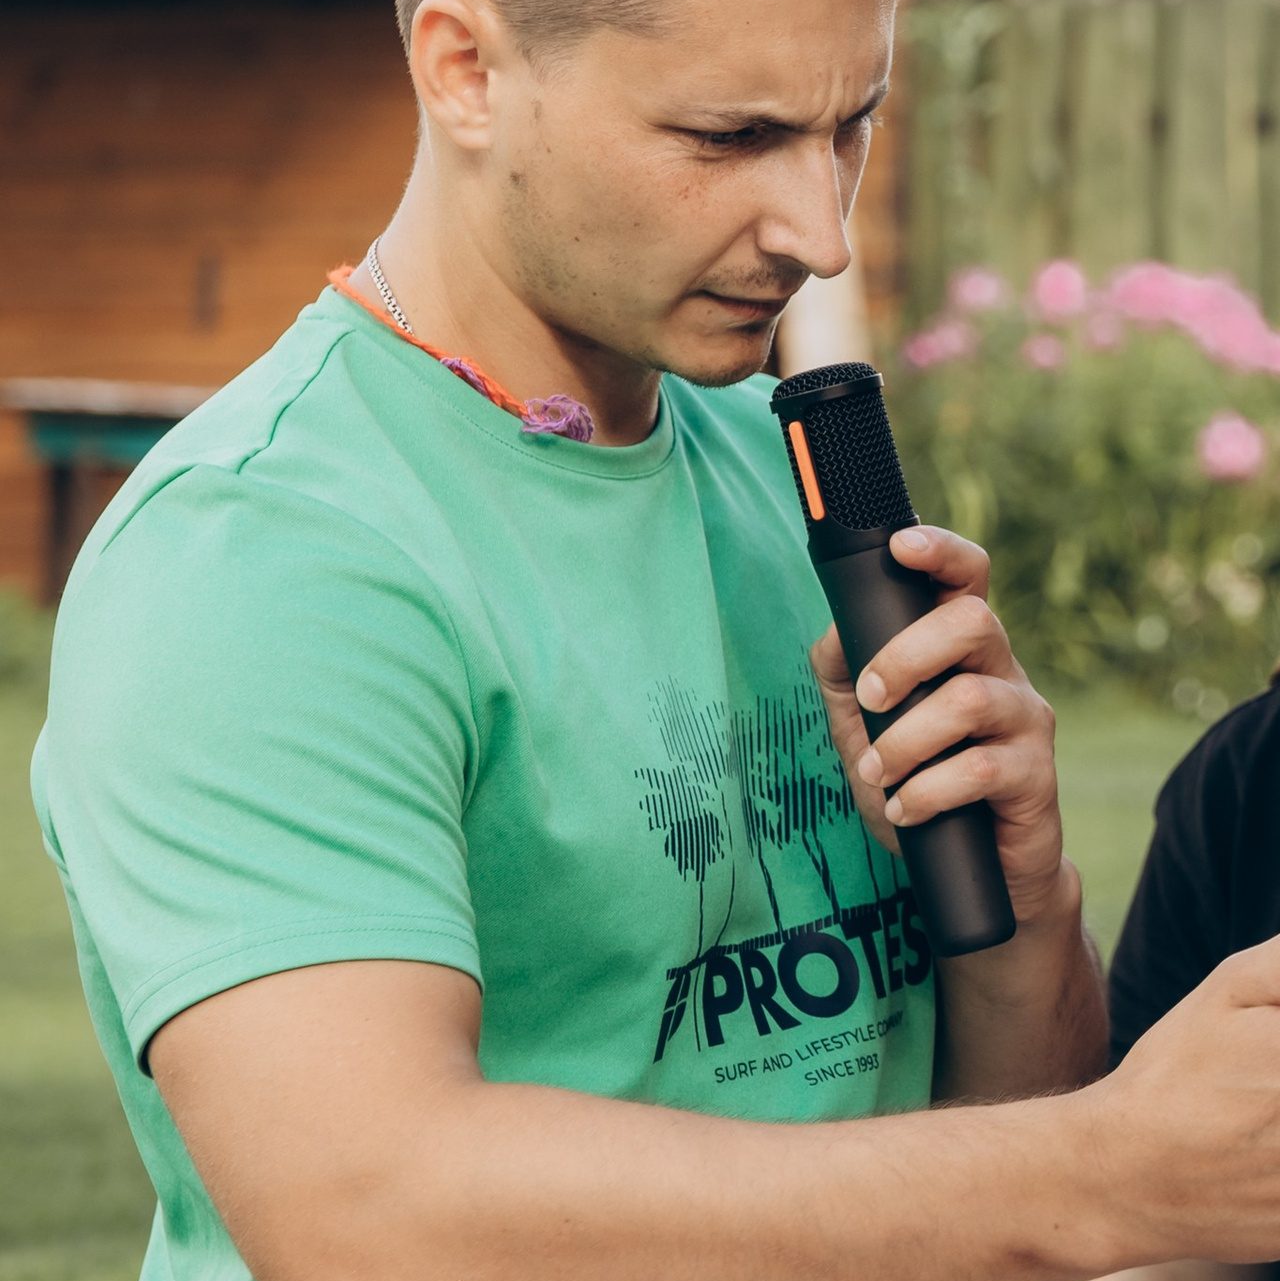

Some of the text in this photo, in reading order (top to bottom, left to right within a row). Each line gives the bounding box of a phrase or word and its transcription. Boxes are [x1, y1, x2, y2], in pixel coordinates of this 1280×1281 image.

[714, 1060, 758, 1084] SURF
[762, 1053, 793, 1074] AND
[795, 1024, 876, 1061] LIFESTYLE
[804, 1053, 880, 1086] SINCE 1993
